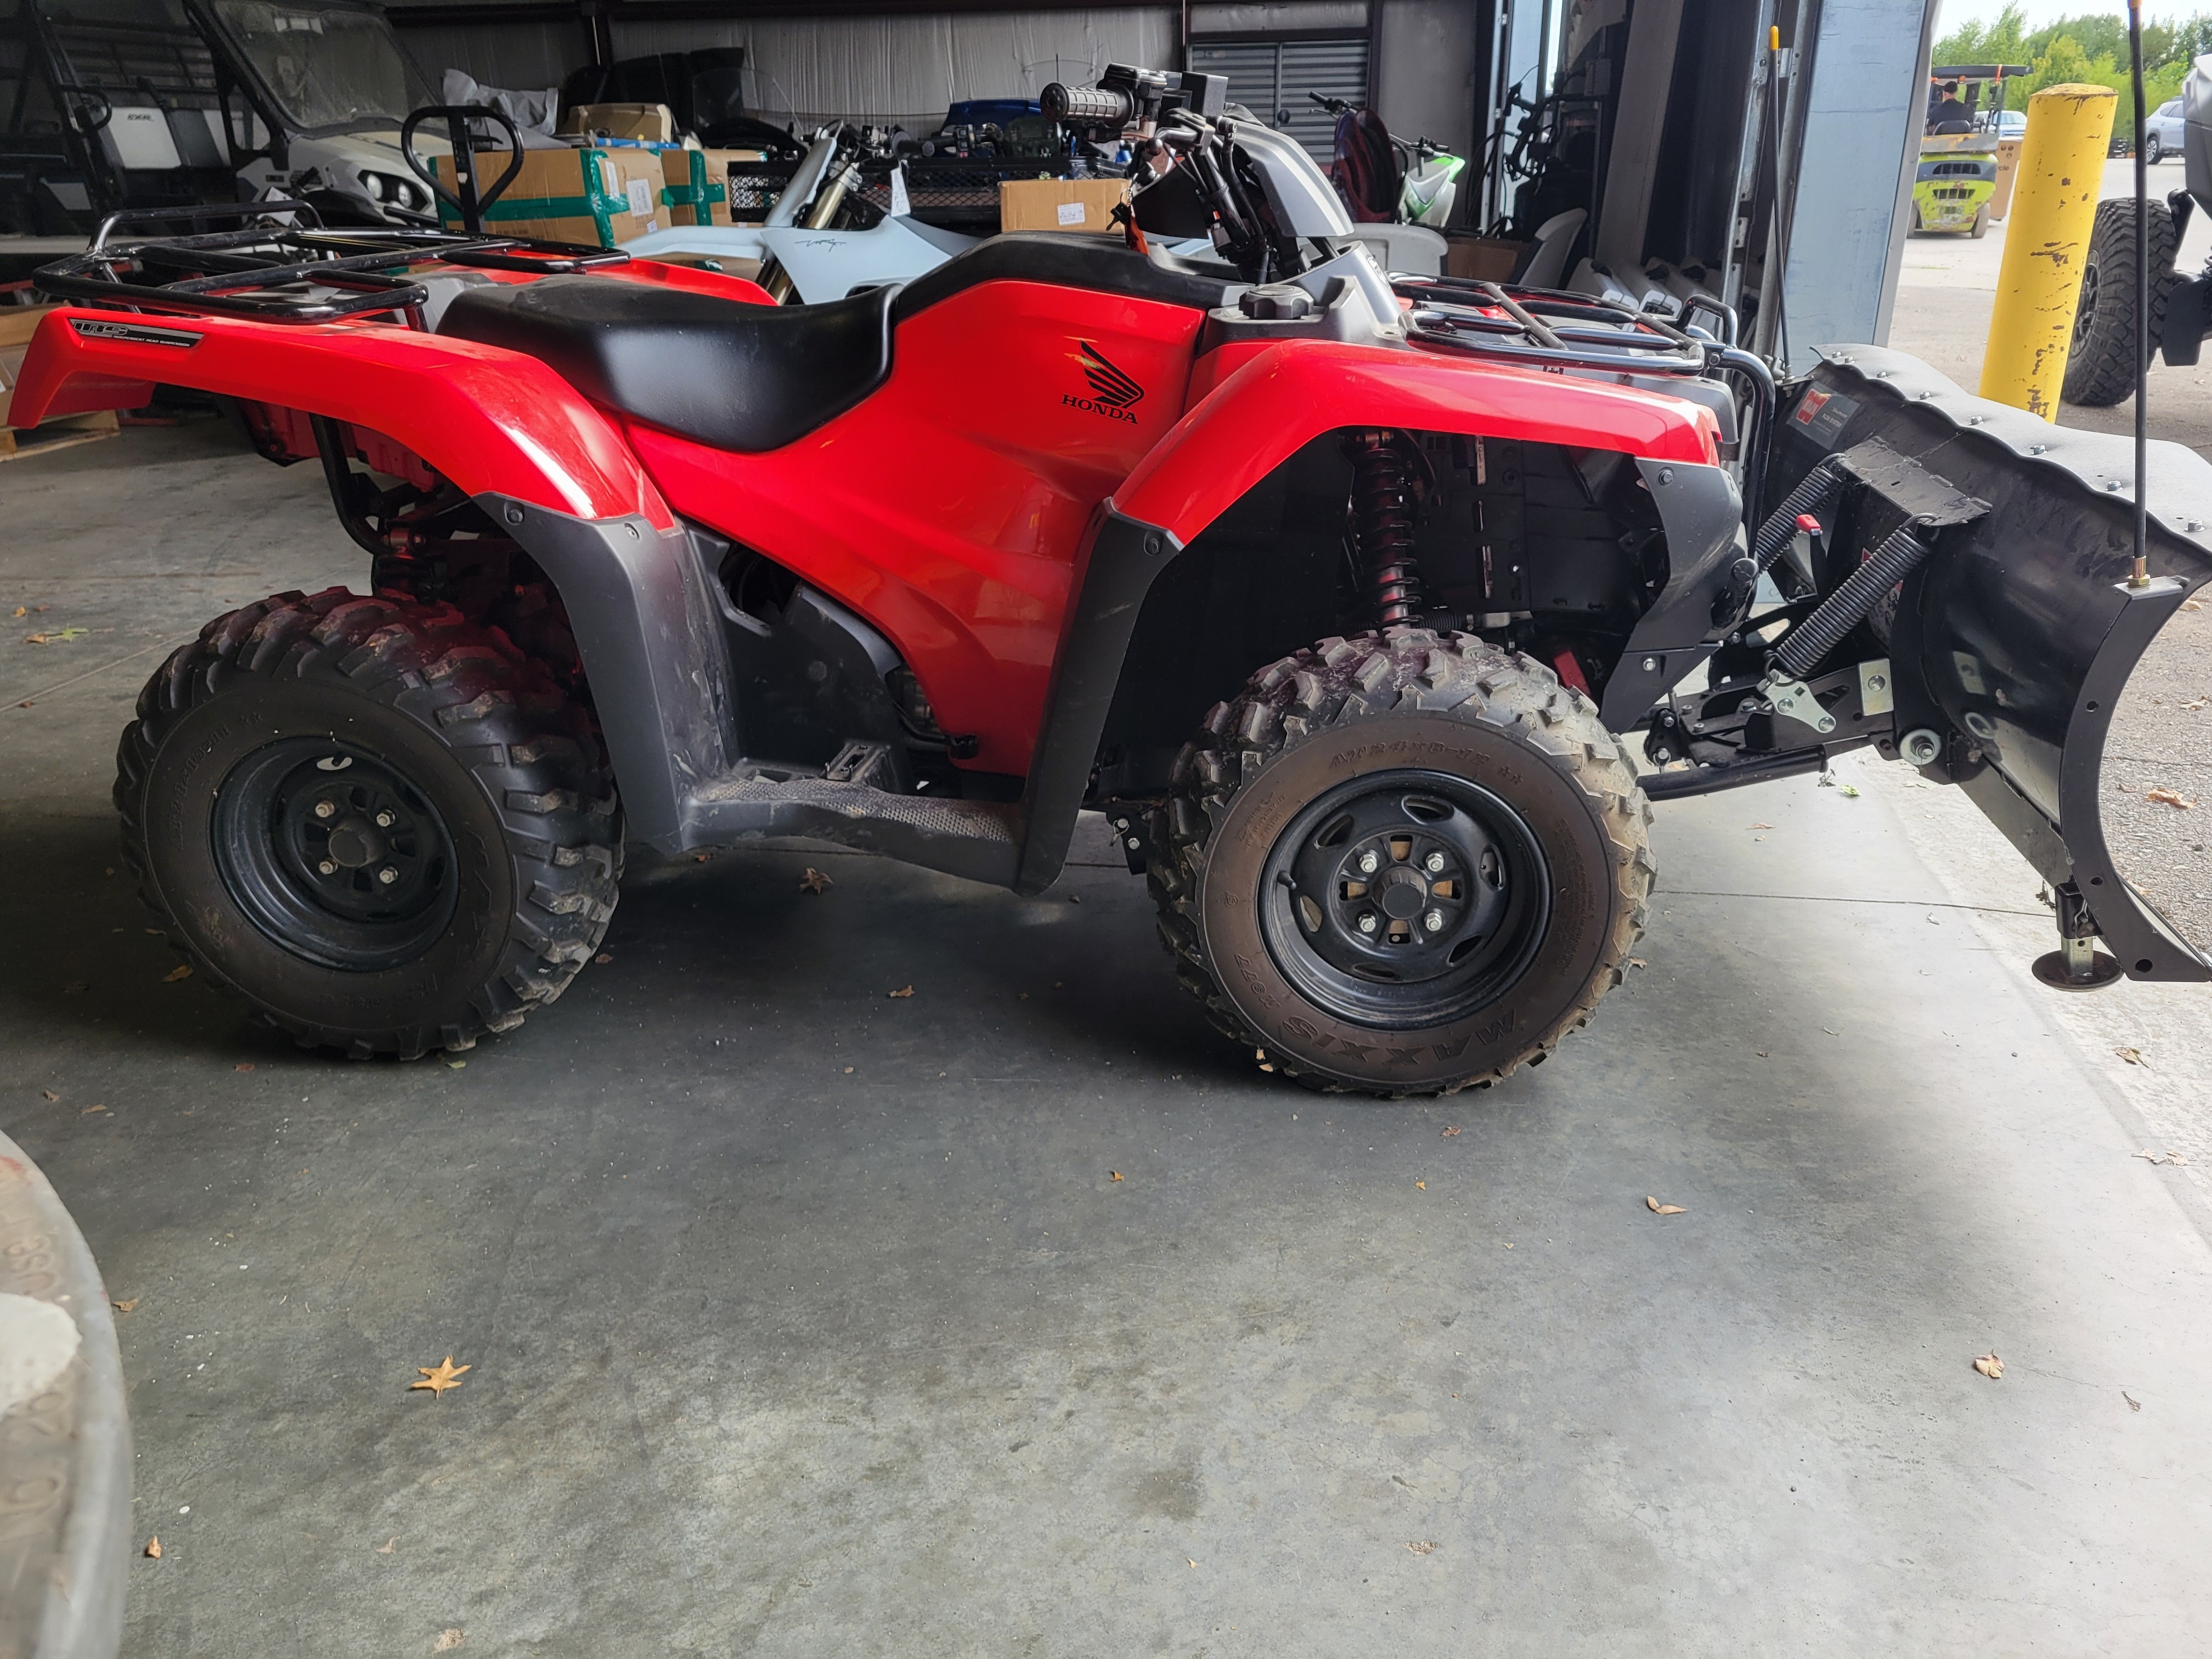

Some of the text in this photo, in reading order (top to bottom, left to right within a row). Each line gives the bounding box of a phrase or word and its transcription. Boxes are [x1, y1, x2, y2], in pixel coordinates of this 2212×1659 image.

[74, 321, 128, 336] IRS
[1061, 393, 1139, 426] HONDA
[1282, 1008, 1516, 1065] MAXXIS
